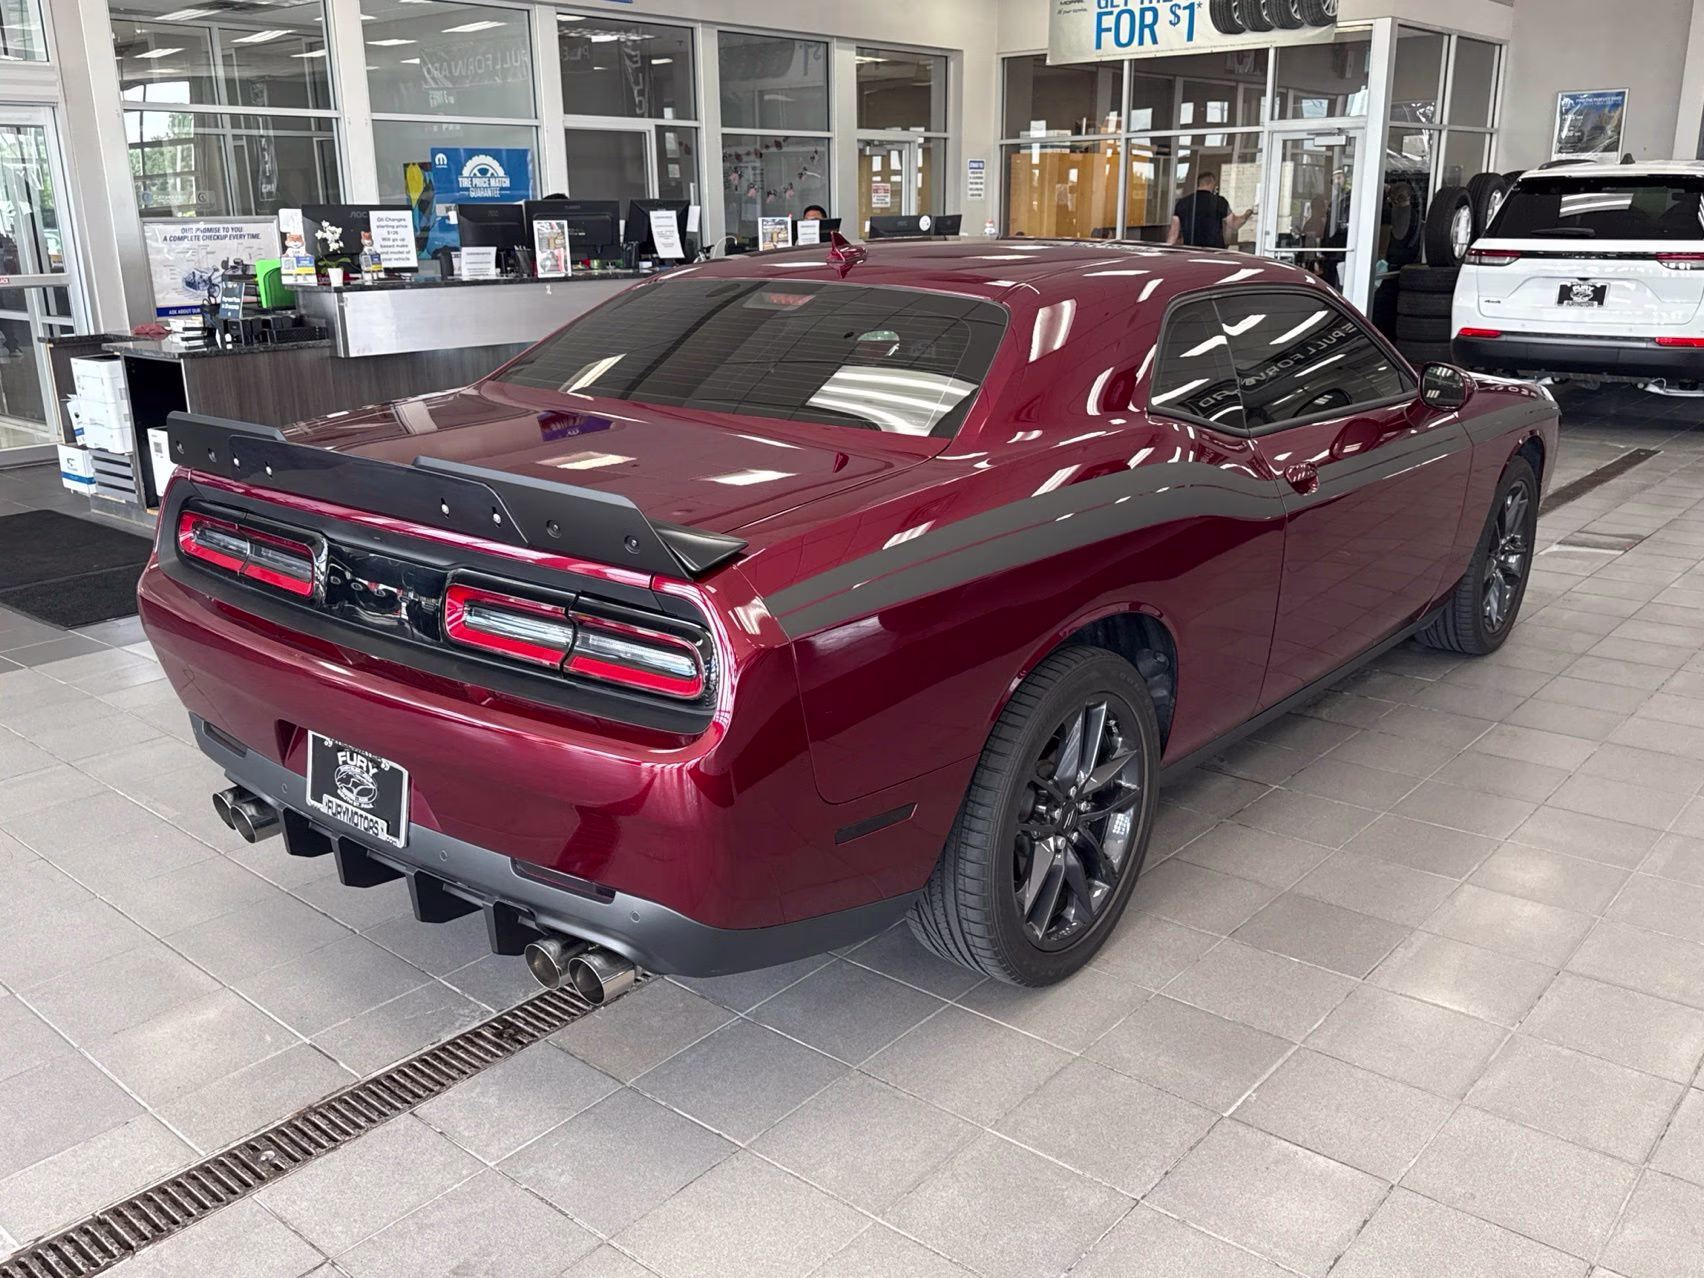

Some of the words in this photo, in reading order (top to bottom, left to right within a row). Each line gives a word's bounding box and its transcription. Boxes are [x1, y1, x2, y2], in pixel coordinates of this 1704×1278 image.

[1095, 6, 1159, 50] FOR
[458, 178, 471, 187] TIRE
[473, 178, 489, 187] PRICE
[490, 178, 510, 187] MATCH
[469, 188, 500, 197] GUARANTEE
[202, 232, 228, 241] CHECKUP
[229, 232, 246, 240] EVERY
[337, 751, 379, 777] FURY
